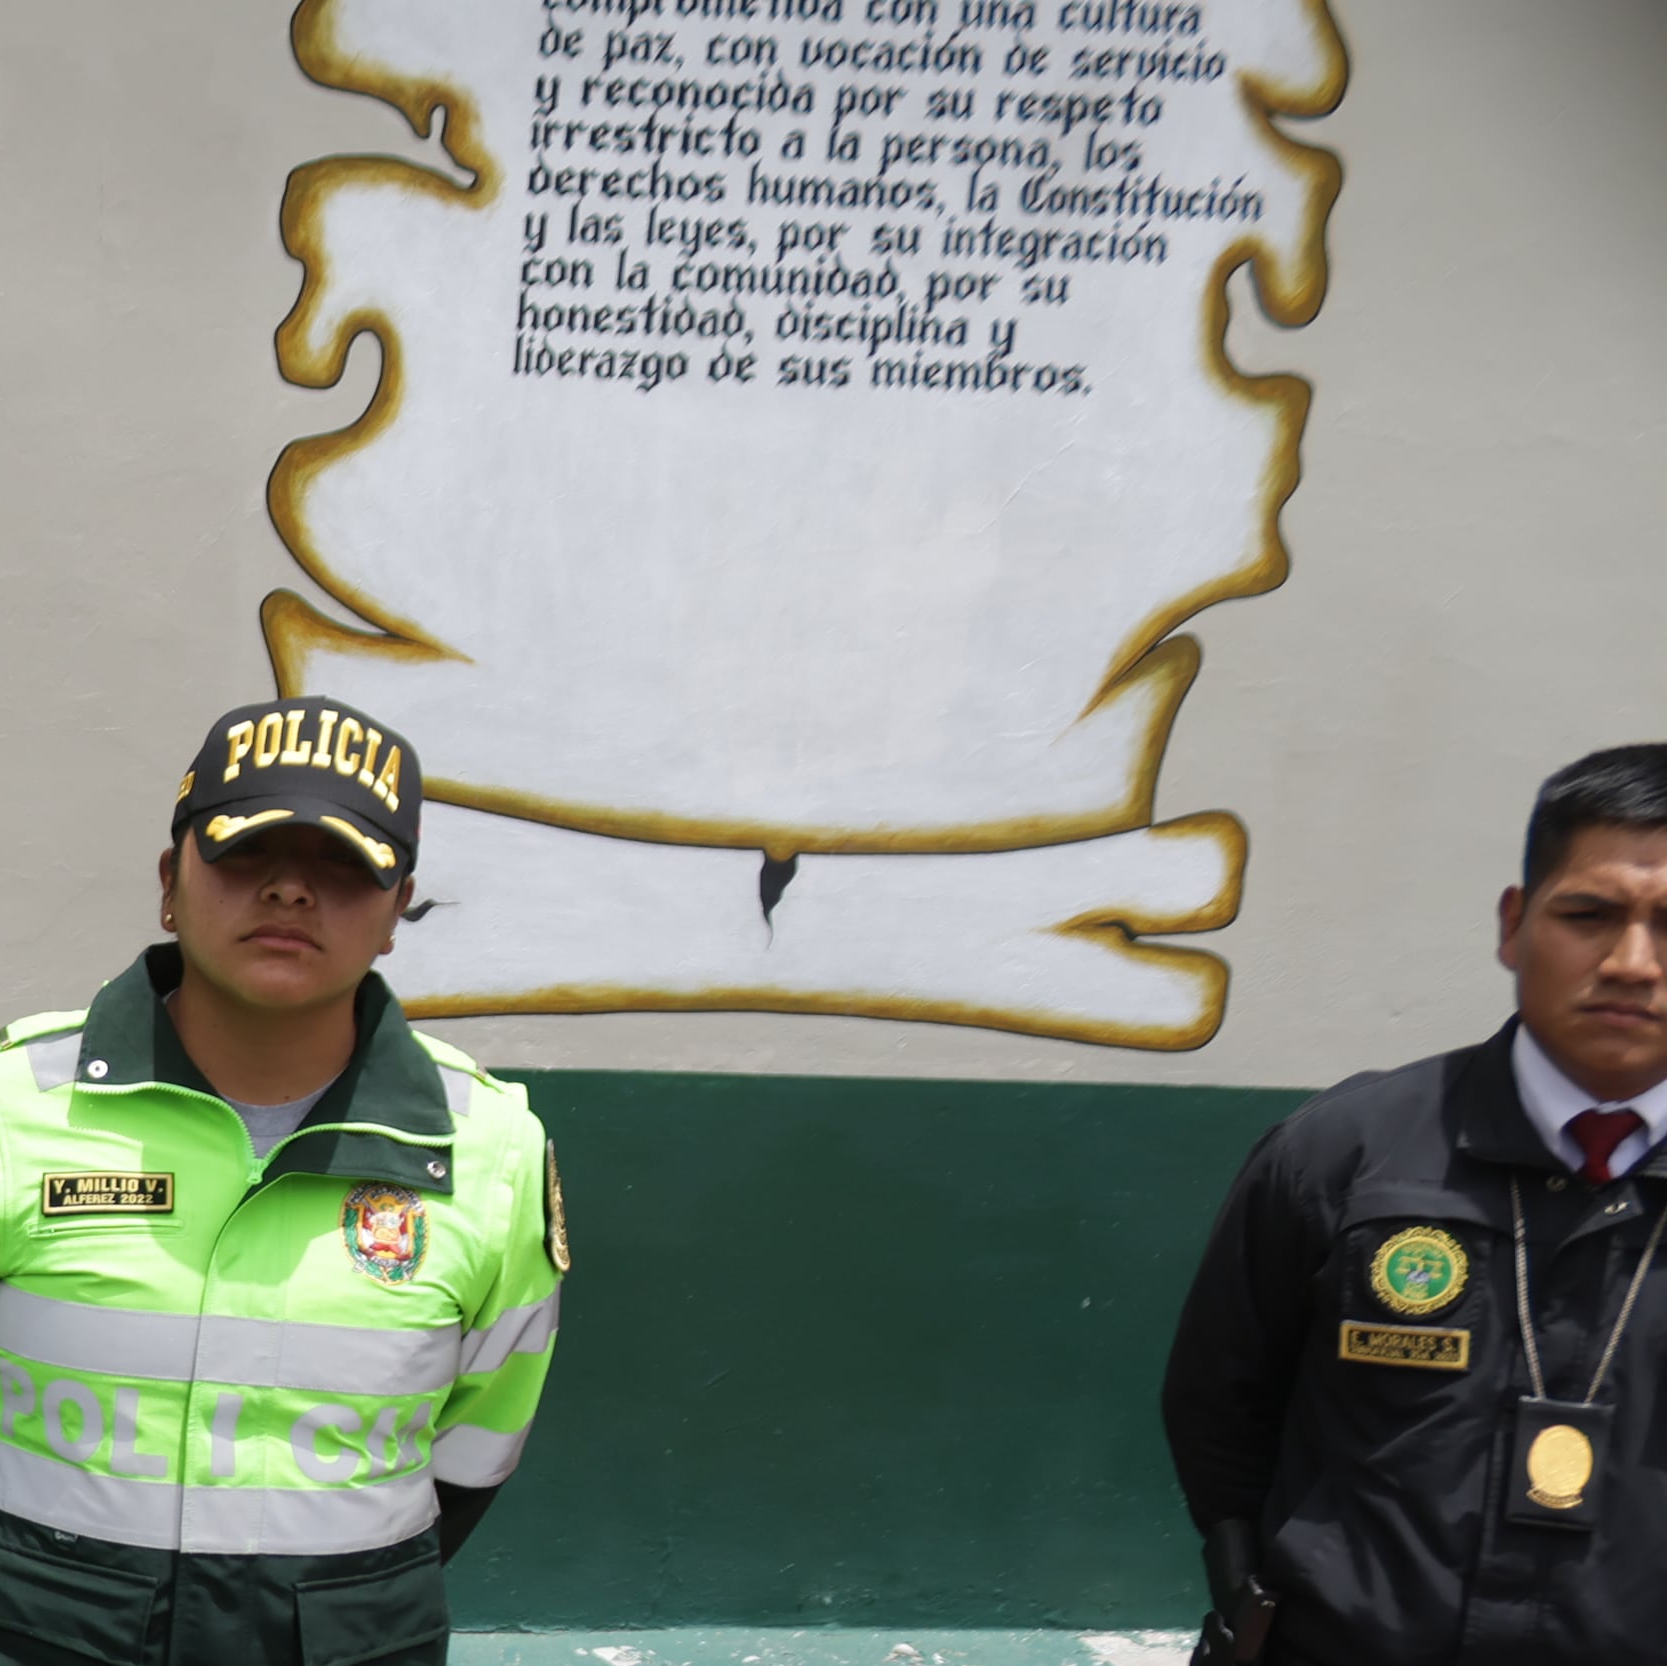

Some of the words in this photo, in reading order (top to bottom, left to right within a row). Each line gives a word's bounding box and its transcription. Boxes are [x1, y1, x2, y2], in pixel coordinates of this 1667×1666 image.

[540, 22, 581, 58] de
[604, 34, 681, 71] paz,
[707, 36, 776, 65] con
[801, 30, 981, 71] vocación
[1005, 44, 1047, 75] de
[1073, 42, 1224, 80] servicio
[536, 77, 559, 117] y
[582, 73, 813, 113] reconocida
[835, 87, 901, 126] por
[928, 90, 973, 118] su
[996, 87, 1162, 132] respeto
[531, 117, 759, 157] irrestricto
[782, 132, 804, 158] a
[828, 123, 859, 160] la
[881, 136, 1059, 176] persona,
[1085, 132, 1140, 171] los
[528, 161, 724, 202] derechos
[748, 168, 942, 214] humanos,
[968, 172, 997, 211] la
[525, 214, 547, 251] y
[568, 204, 622, 244] las
[647, 208, 755, 257] leyes,
[777, 223, 846, 260] por
[872, 225, 919, 254] su
[943, 215, 1166, 268] integración
[521, 259, 592, 291] con
[616, 253, 648, 290] la
[672, 258, 903, 307] comunidad,
[926, 274, 994, 313] por
[1023, 276, 1068, 303] su
[517, 297, 752, 346] honestidad,
[776, 305, 967, 354] disciplina
[991, 321, 1016, 358] y
[514, 341, 688, 390] liderazgo
[708, 347, 755, 383] de
[779, 357, 849, 387] sus
[872, 353, 1089, 393] miembros.
[223, 709, 402, 813] POLICIA
[53, 1179, 70, 1194] Y.
[77, 1178, 139, 1192] MILLIO
[145, 1179, 163, 1192] V.
[63, 1193, 115, 1205] ALFEREZ
[121, 1193, 153, 1204] 2022
